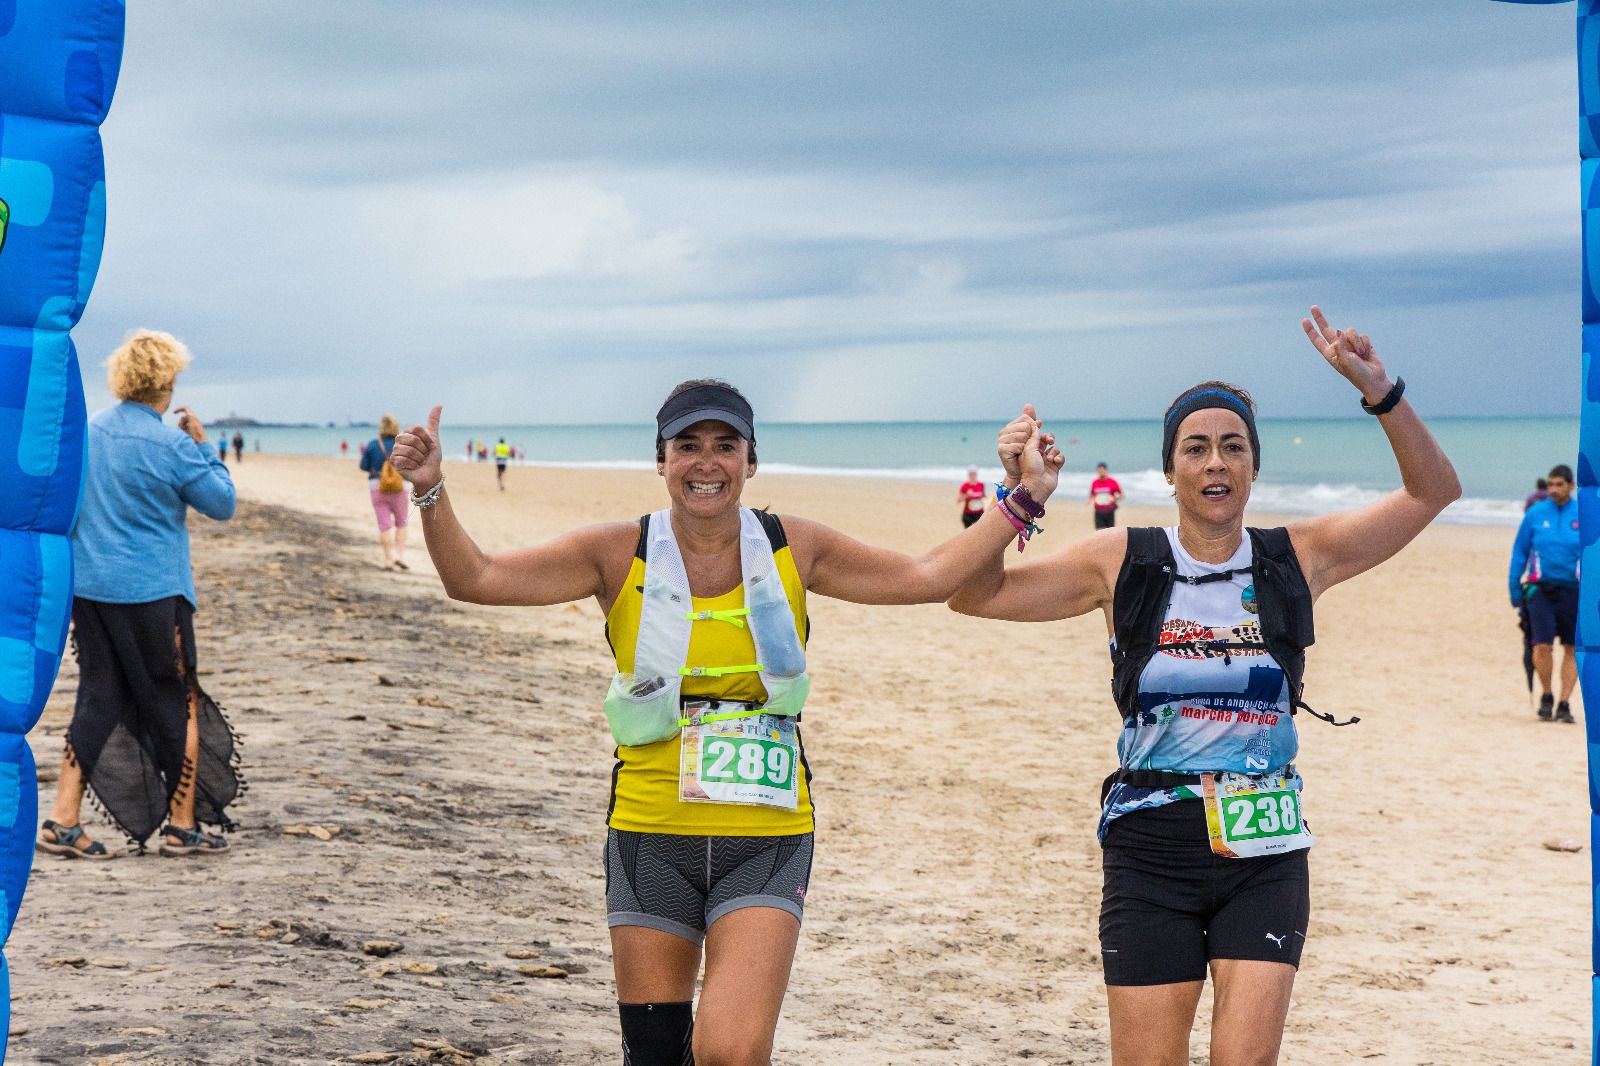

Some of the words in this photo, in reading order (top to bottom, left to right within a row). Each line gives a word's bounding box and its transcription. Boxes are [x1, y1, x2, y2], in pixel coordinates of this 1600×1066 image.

[1181, 706, 1233, 723] marcha
[1213, 697, 1225, 706] DE
[706, 740, 790, 784] 289
[1227, 795, 1297, 837] 238
